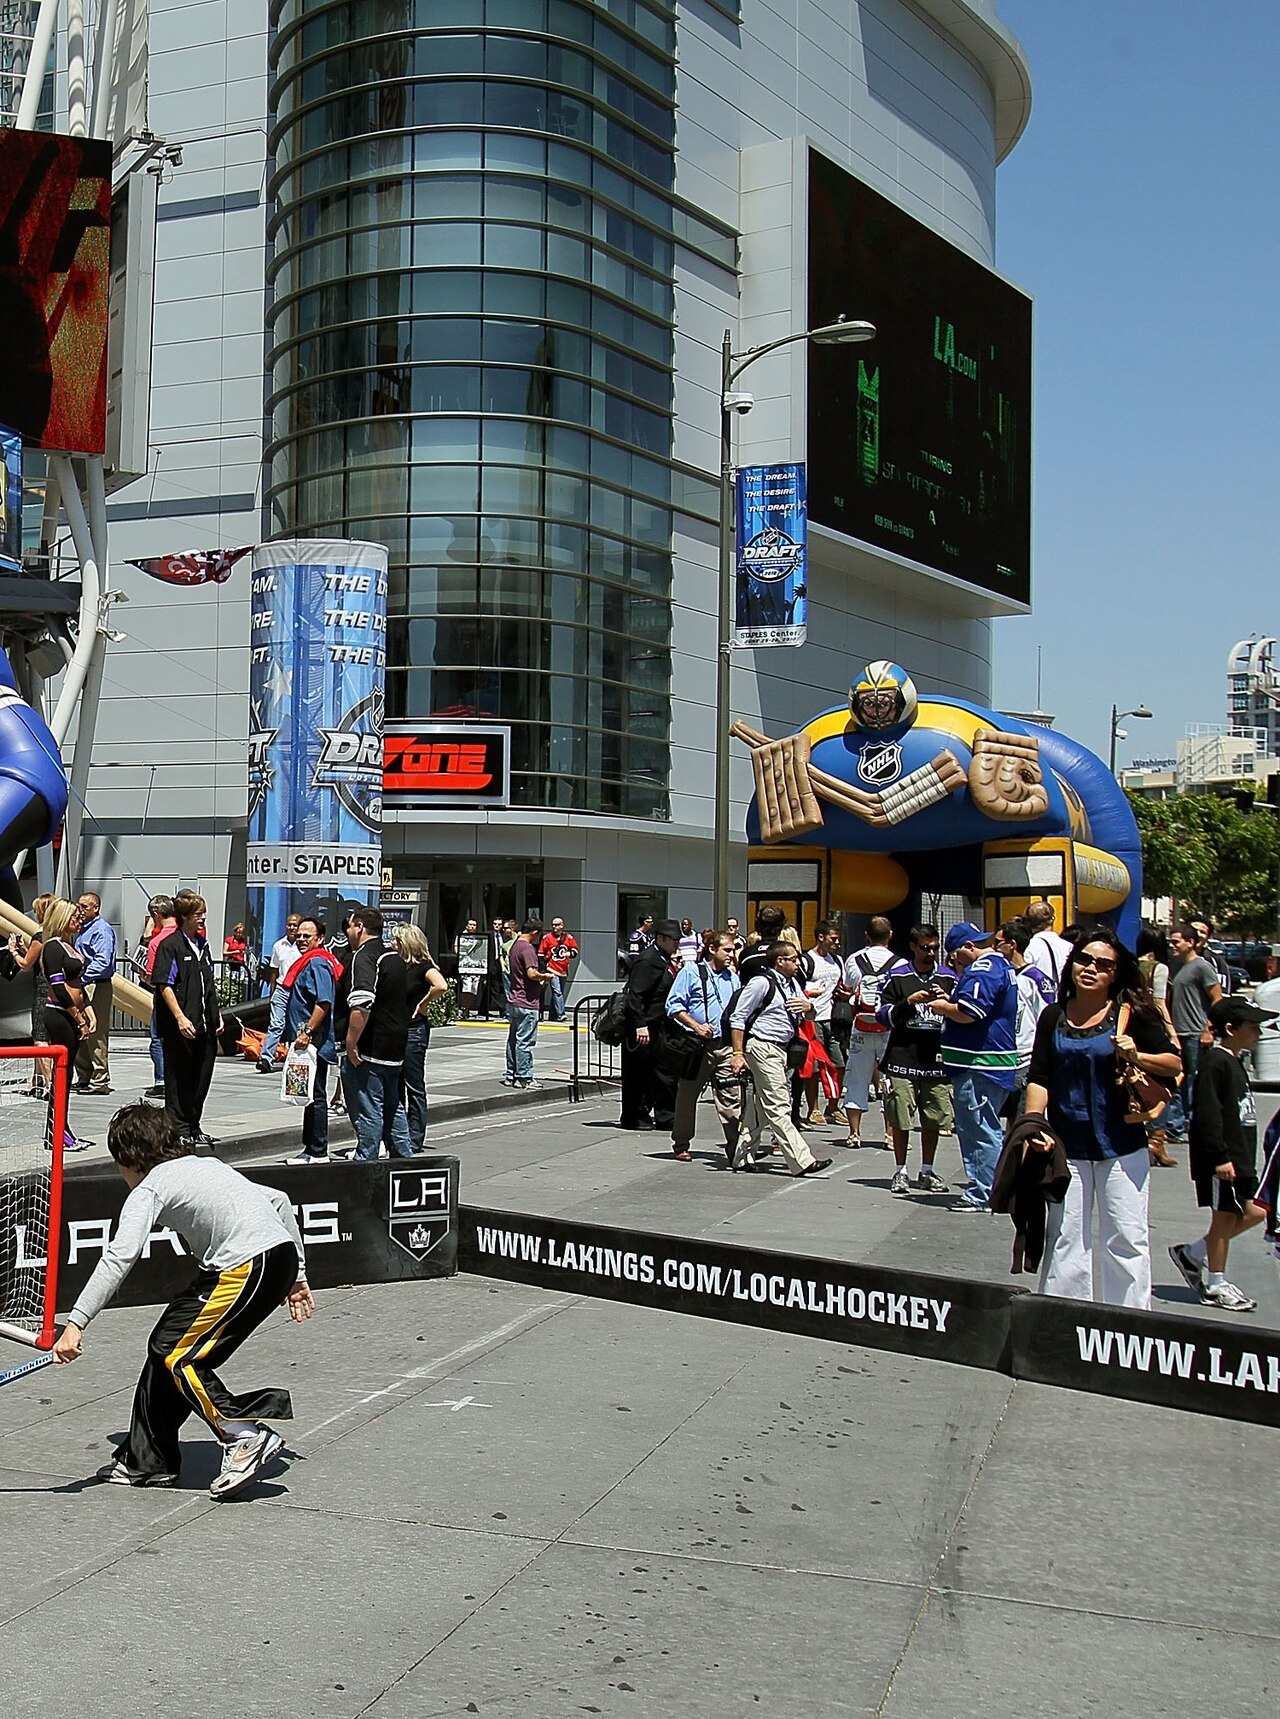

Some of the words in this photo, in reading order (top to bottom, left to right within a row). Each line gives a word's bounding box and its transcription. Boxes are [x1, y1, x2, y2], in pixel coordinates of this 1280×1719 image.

[748, 505, 766, 513] THE
[742, 544, 801, 558] DRAFT
[251, 575, 278, 594] AM.
[325, 573, 372, 593] THE
[251, 610, 277, 630] RE.
[324, 609, 371, 629] THE
[740, 631, 768, 639] STAPLES
[330, 645, 373, 664] THE
[867, 751, 893, 776] NHL
[1132, 758, 1177, 768] Washingto
[293, 854, 375, 876] STAPLES
[973, 981, 981, 999] 1
[887, 1062, 910, 1075] LOS
[392, 1176, 447, 1208] LA
[476, 1225, 952, 1333] WWW.LAKINGS.COM/LOCALHOCKEY
